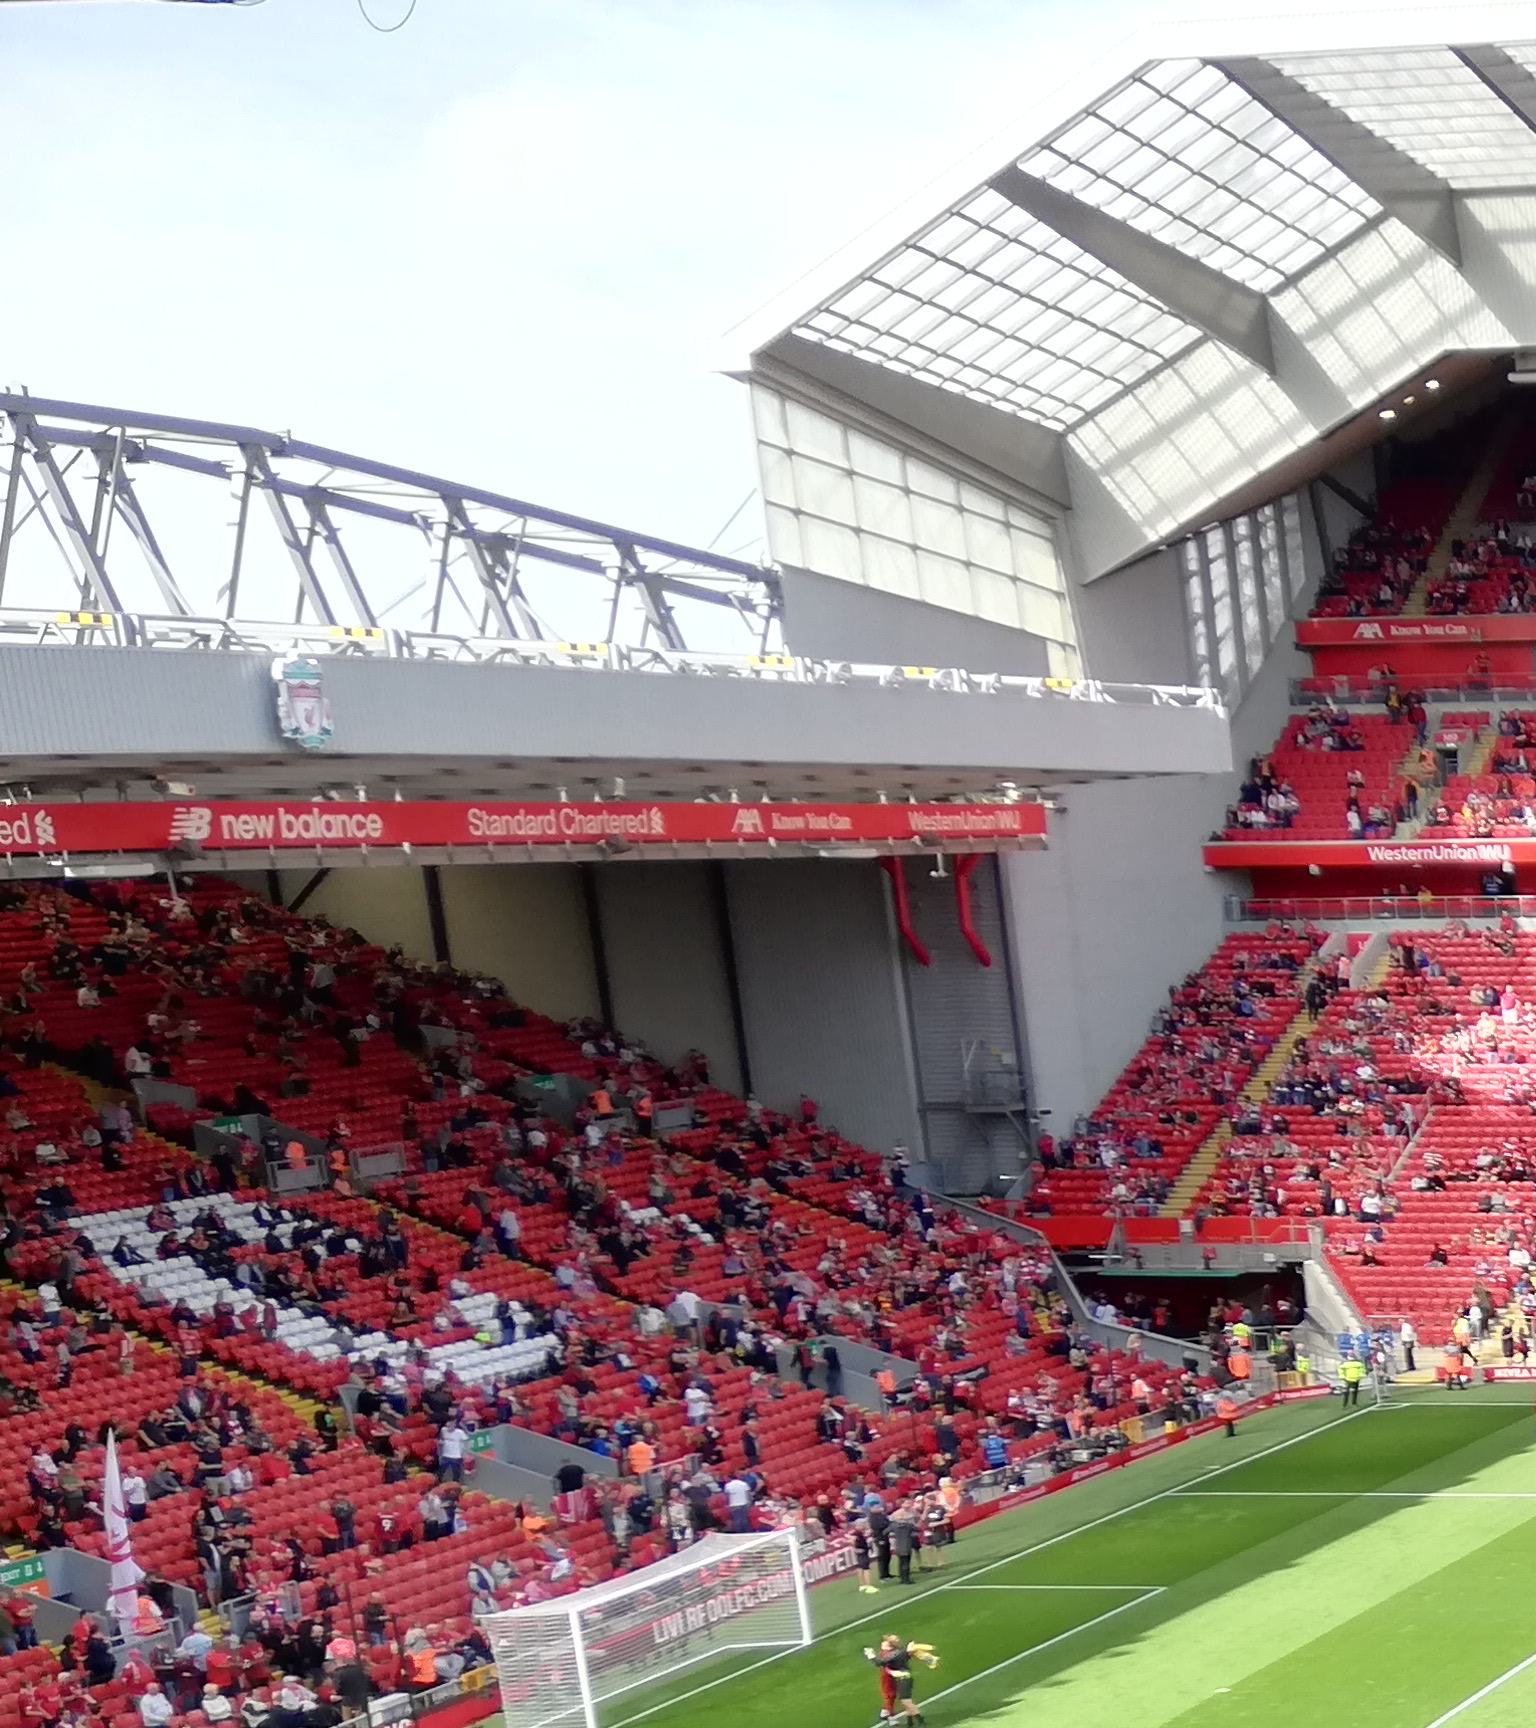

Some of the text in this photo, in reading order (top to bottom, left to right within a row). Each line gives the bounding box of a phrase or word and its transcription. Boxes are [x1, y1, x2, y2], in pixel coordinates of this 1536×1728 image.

[1353, 623, 1385, 638] AXA
[1391, 624, 1420, 635] Know
[1423, 624, 1445, 635] You
[221, 814, 275, 840] new
[280, 808, 383, 840] balance
[467, 808, 650, 836] Standard Chartered
[772, 813, 802, 830] Know
[804, 813, 828, 830] You
